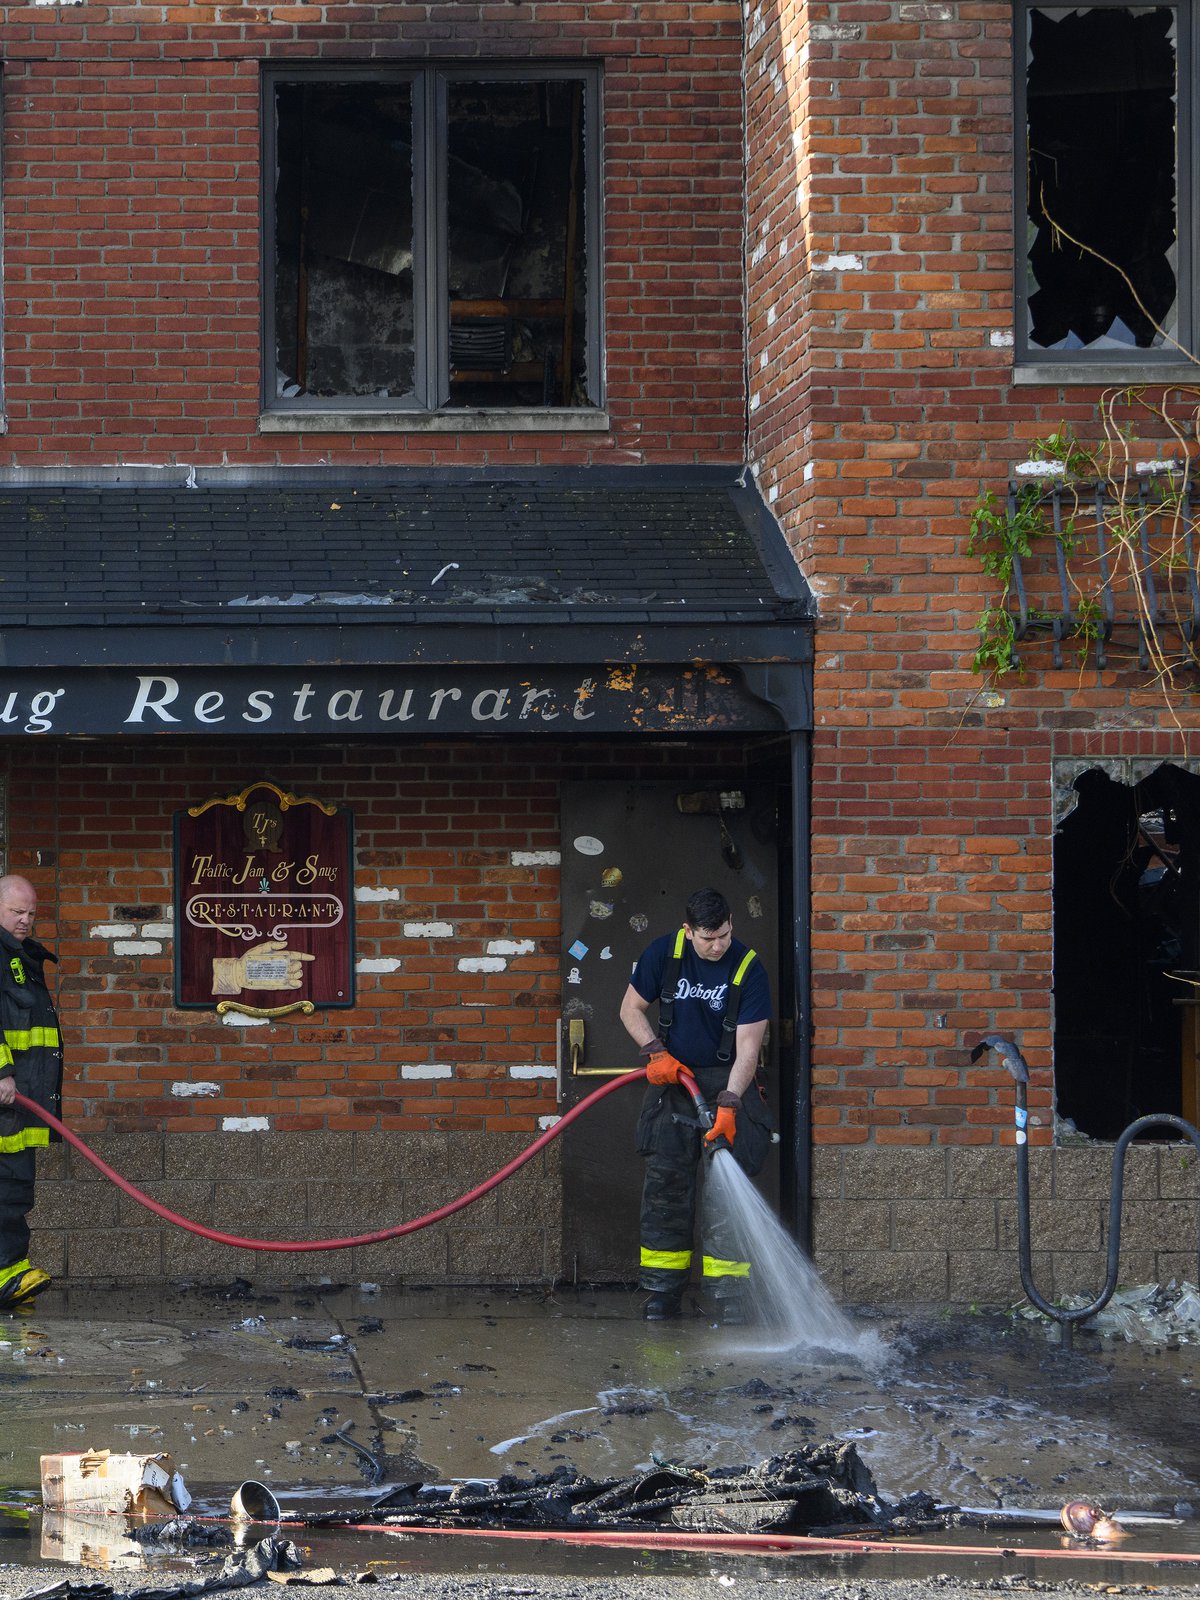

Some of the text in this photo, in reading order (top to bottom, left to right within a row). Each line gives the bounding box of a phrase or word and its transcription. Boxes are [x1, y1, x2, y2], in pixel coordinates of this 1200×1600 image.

[123, 676, 598, 724] Restaurant
[191, 854, 339, 885] Traffic Jam & Snug
[674, 977, 729, 1000] Detroit
